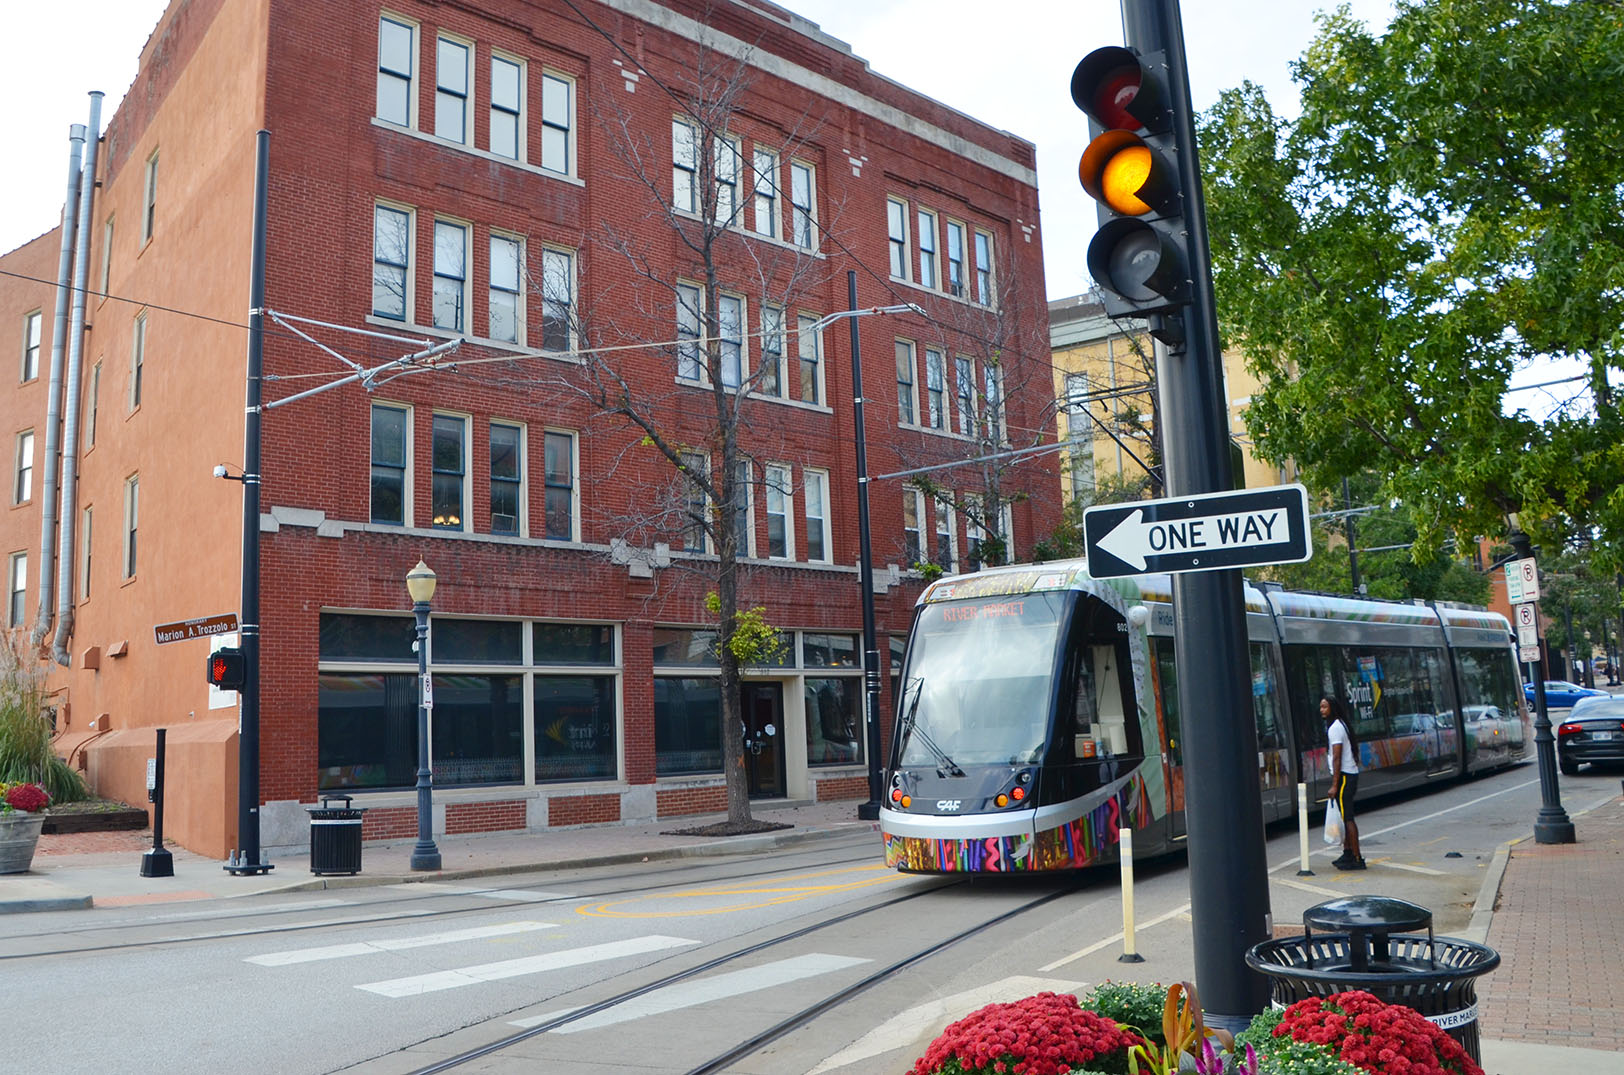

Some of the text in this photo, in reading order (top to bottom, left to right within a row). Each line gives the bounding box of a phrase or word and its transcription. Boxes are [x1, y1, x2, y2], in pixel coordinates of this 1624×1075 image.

[1149, 512, 1278, 551] ONE WAY
[943, 601, 1024, 622] RIVER MARKET
[157, 630, 185, 642] Marion
[188, 626, 197, 637] A.
[196, 622, 228, 635] Trozzolo
[1346, 682, 1372, 709] Sprint
[936, 800, 961, 811] CAF
